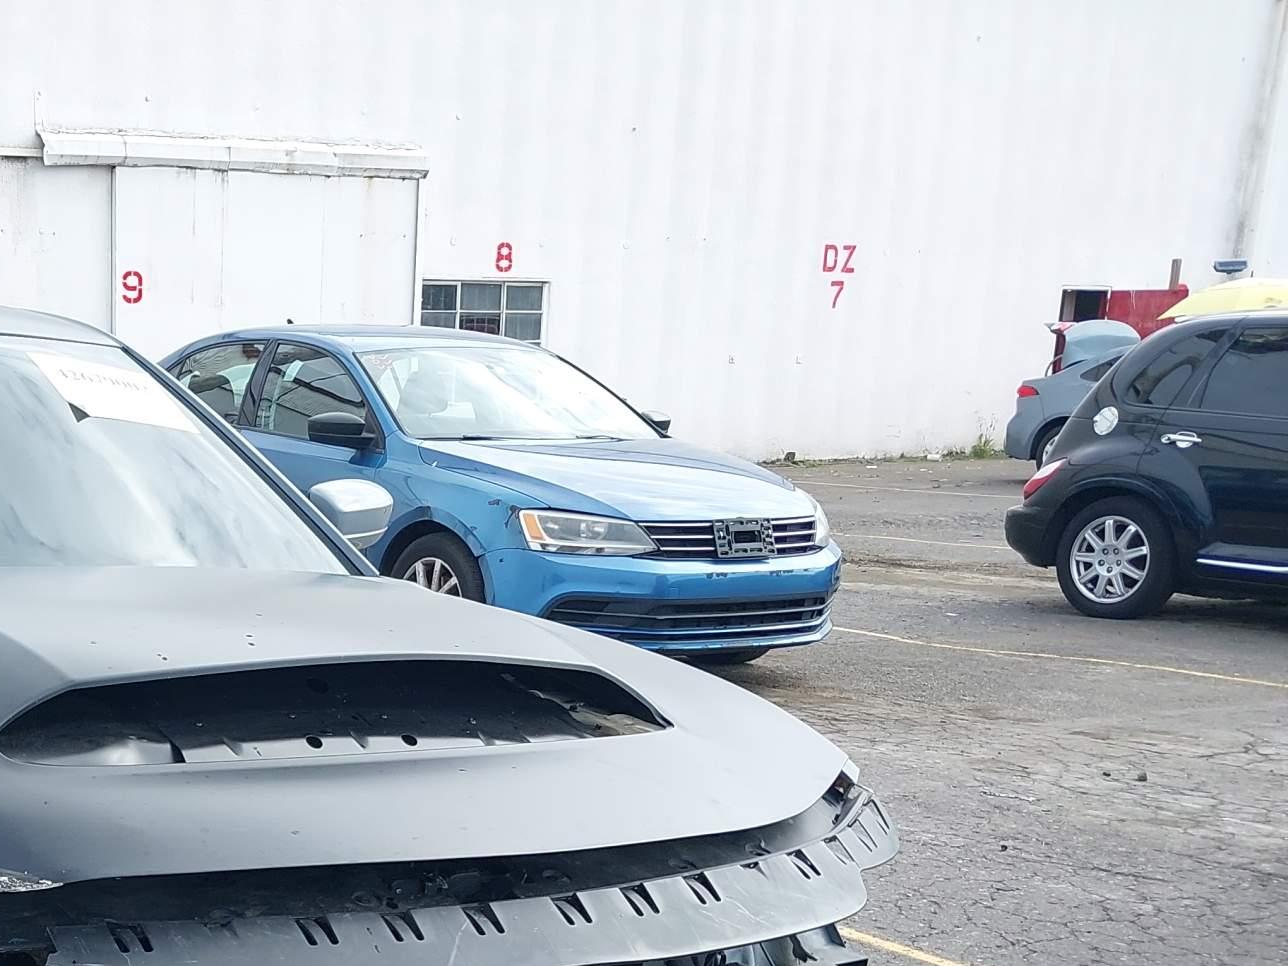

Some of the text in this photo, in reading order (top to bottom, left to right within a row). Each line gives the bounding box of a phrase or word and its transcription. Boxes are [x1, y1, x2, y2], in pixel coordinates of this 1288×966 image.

[495, 242, 513, 273] 8
[822, 244, 857, 274] DZ
[121, 270, 144, 305] 9
[830, 281, 845, 309] 7
